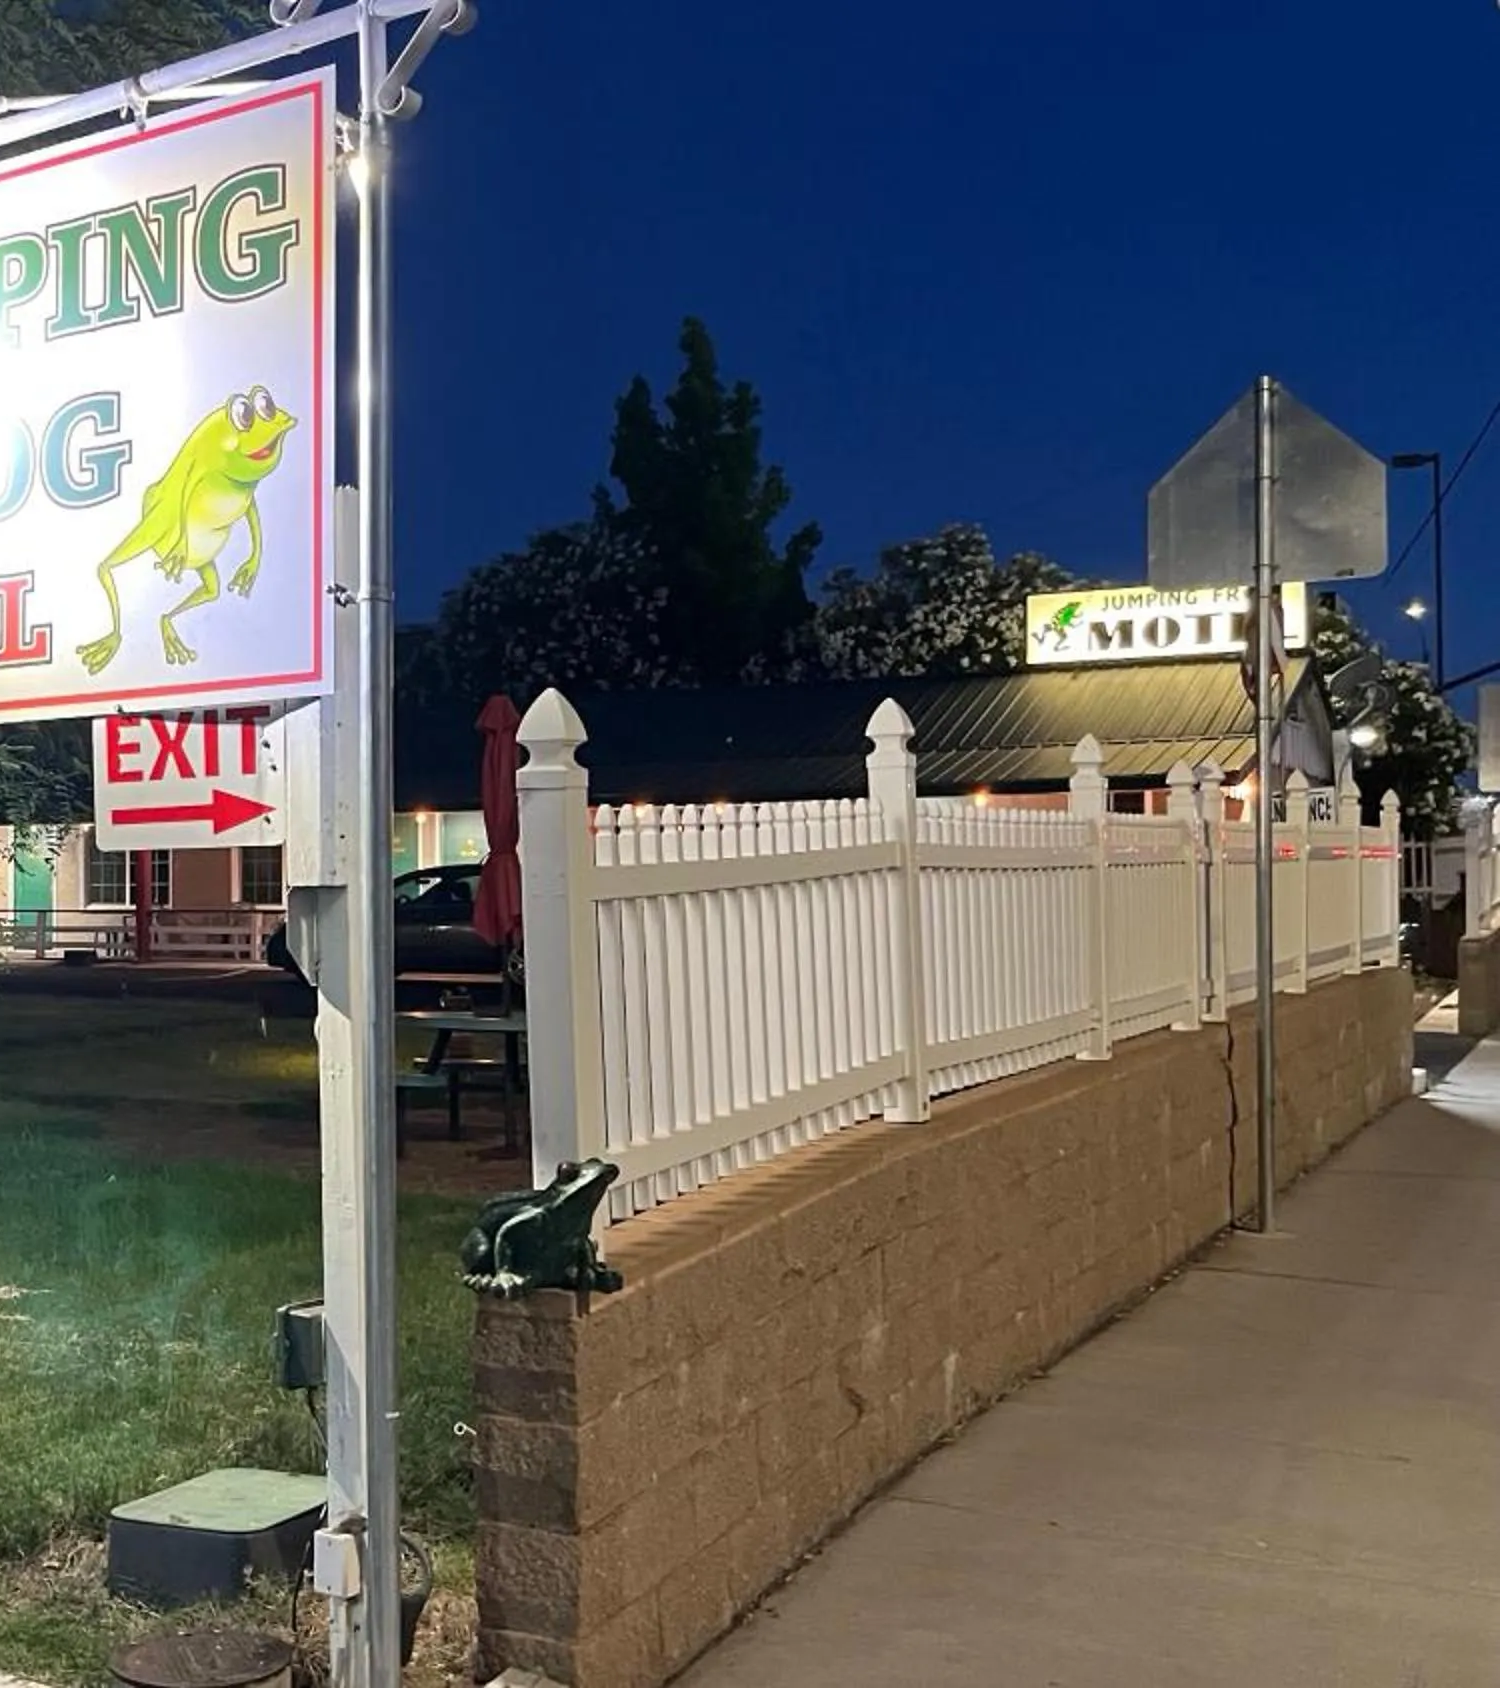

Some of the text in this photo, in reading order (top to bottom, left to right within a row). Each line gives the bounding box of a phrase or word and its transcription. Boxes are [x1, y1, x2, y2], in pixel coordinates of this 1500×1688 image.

[1101, 590, 1197, 612] JUMPING
[1088, 611, 1298, 651] MOT
[105, 705, 271, 784] EXIT
